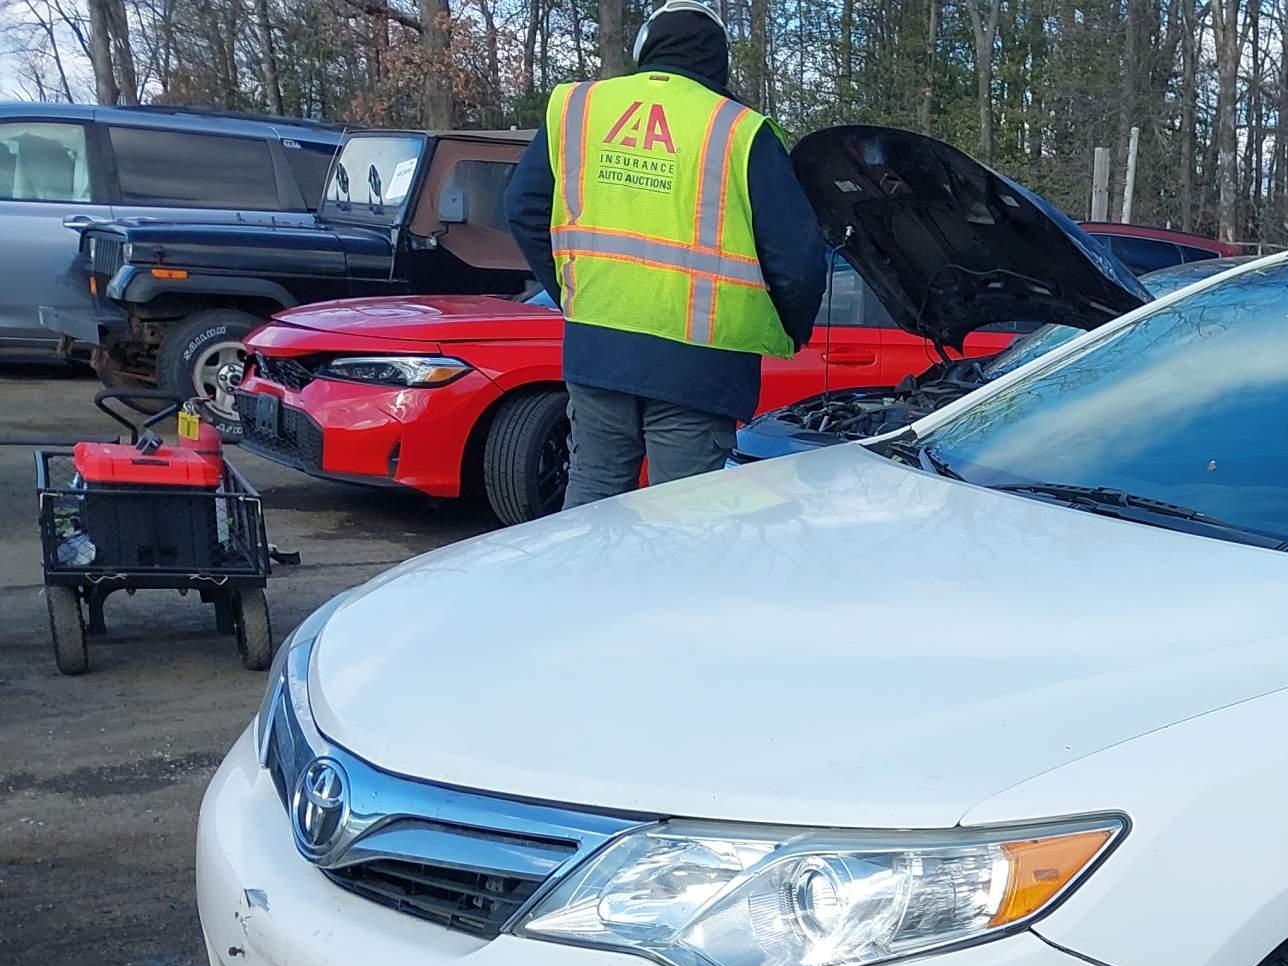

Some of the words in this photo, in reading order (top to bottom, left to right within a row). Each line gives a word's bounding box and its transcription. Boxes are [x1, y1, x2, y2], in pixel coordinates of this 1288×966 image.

[600, 153, 675, 174] INSURANCE
[598, 169, 623, 182] AUTO
[624, 173, 672, 190] AUCTIONS
